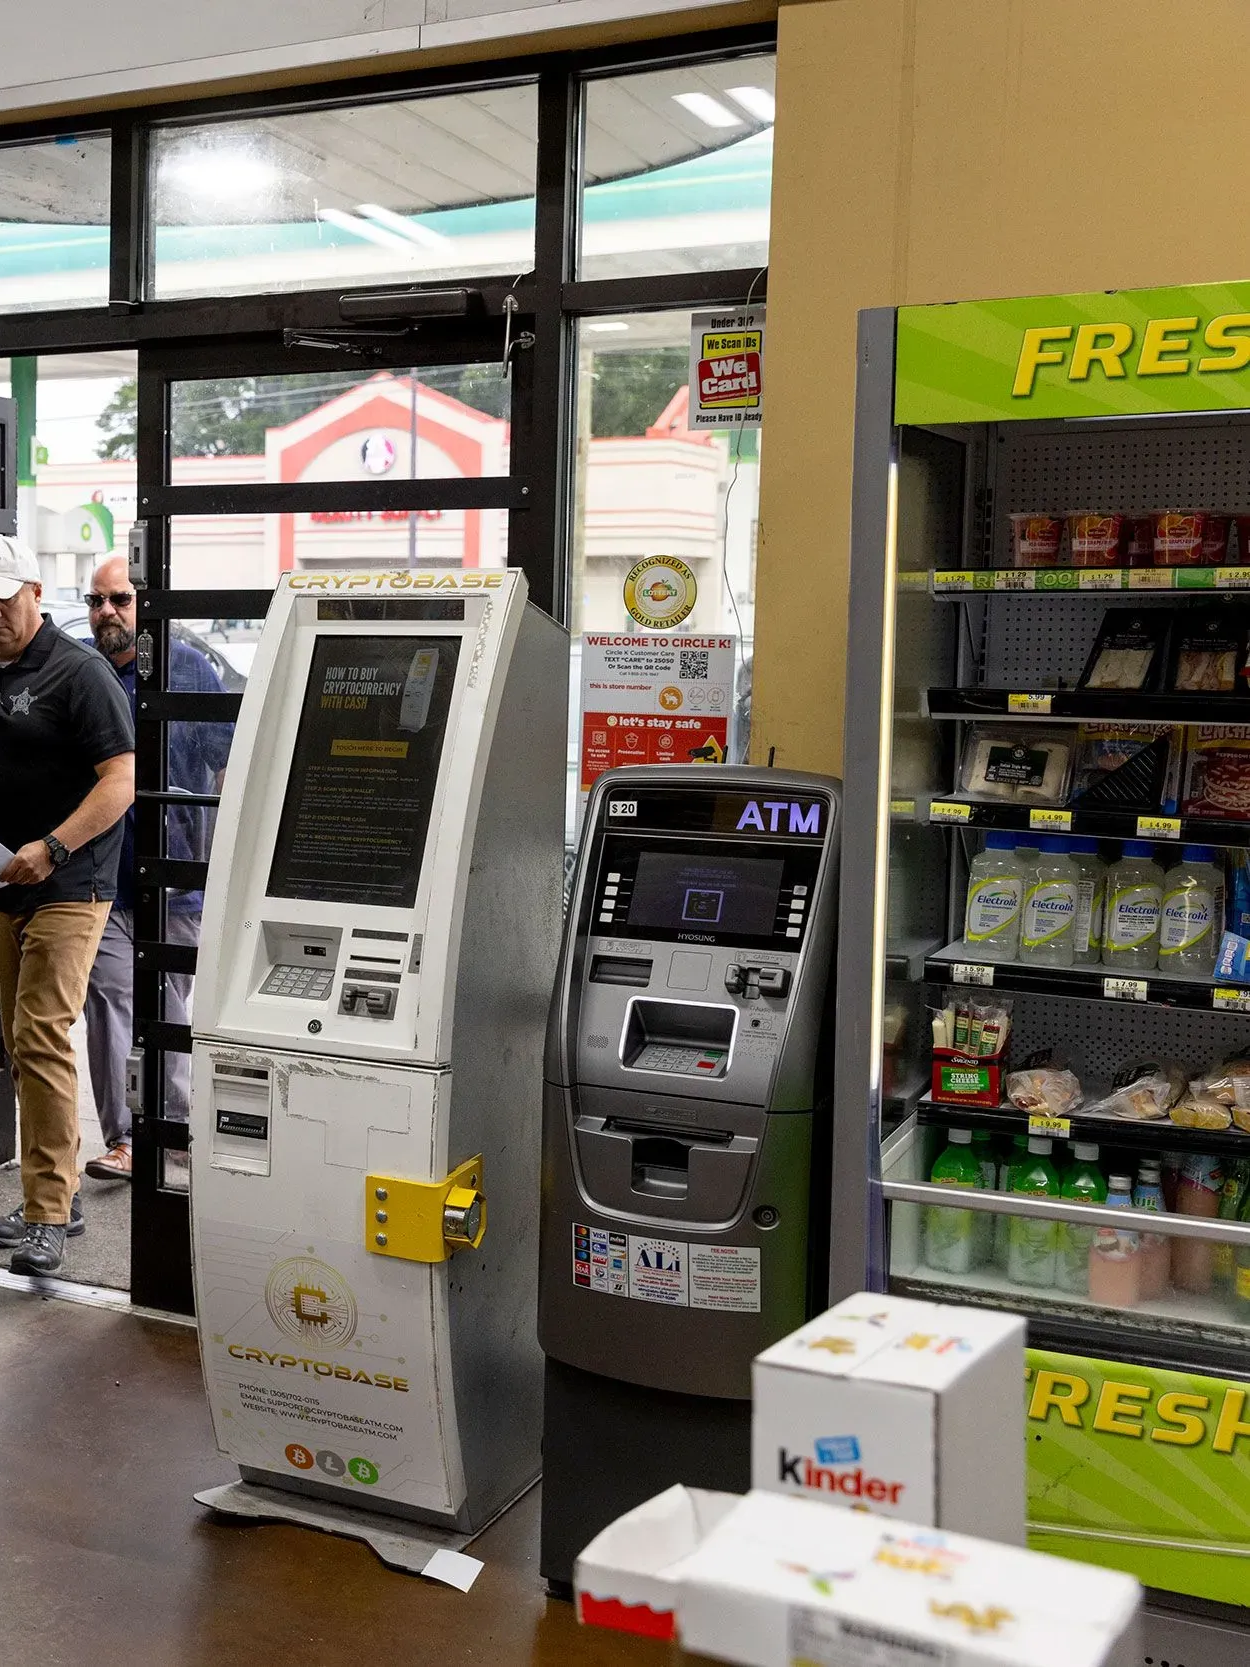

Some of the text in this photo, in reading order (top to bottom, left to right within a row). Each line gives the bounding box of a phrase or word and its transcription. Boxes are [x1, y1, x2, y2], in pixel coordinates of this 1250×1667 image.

[711, 318, 735, 329] Under
[707, 339, 719, 350] We
[721, 338, 741, 349] Scan
[710, 358, 747, 377] We
[701, 371, 757, 395] Card
[696, 413, 762, 423] Please Have ID Ready
[628, 556, 692, 583] RECOGNIZED AS
[287, 572, 504, 590] CRYPTOBASE
[643, 589, 678, 597] LOTTERY
[630, 604, 692, 628] GOLD RETAILER
[587, 636, 731, 649] WELCOME TO CIRCLE K!
[325, 666, 379, 681] HOW TO BUY
[322, 681, 402, 697] CRYPTOCURRENCY
[625, 683, 652, 691] number
[320, 695, 369, 711] WITH CASH
[619, 716, 702, 730] let's stay safe
[620, 803, 635, 814] 20
[735, 800, 821, 834] ATM
[977, 894, 1018, 907] Electrolit
[1031, 899, 1074, 912] Electrolit
[1165, 907, 1209, 921] Electrolit
[677, 932, 716, 943] HYOSUNG
[592, 1231, 607, 1240] VISA
[576, 1266, 589, 1274] STAR
[228, 1343, 410, 1393] CRYPTOBASE
[238, 1382, 269, 1396] PHONE:
[240, 1392, 404, 1433] EMAIL: SUPPORT@CRYPTOBASEATM.COM
[1024, 1367, 1250, 1453] RESH
[242, 1401, 398, 1442] WEBSITE: WWW.CRYPTOBASEATM.COM
[777, 1447, 906, 1505] kinder
